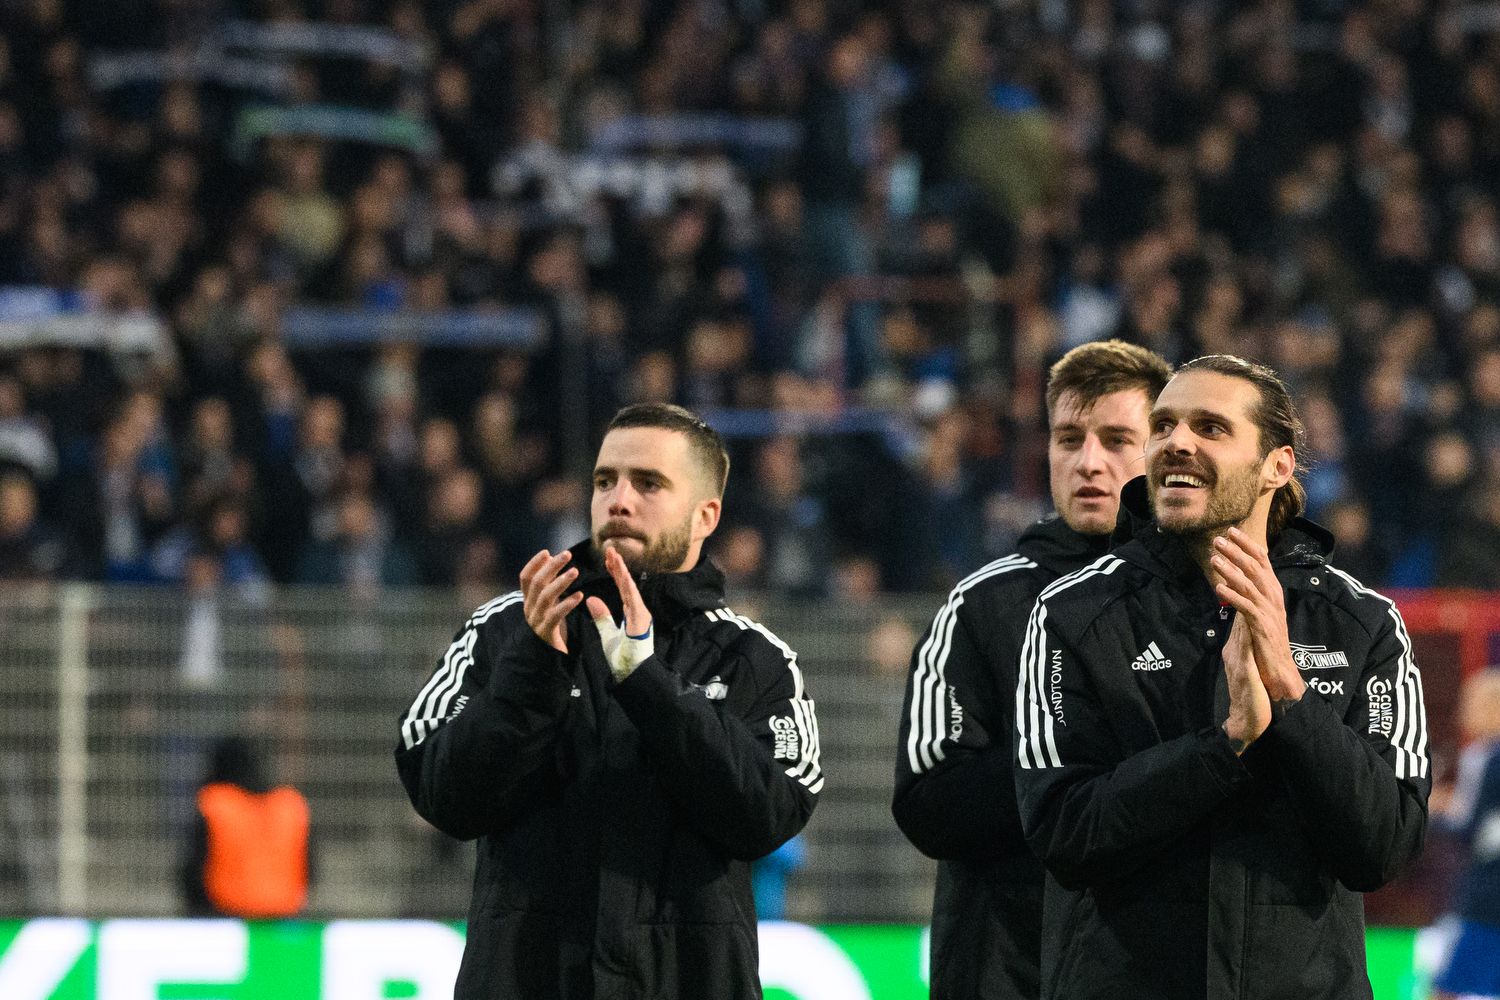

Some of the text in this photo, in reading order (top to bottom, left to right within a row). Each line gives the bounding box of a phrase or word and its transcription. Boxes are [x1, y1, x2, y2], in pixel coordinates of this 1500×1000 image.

[1131, 659, 1173, 671] adidas
[1305, 677, 1344, 696] fox
[1380, 695, 1394, 738] COMEDY
